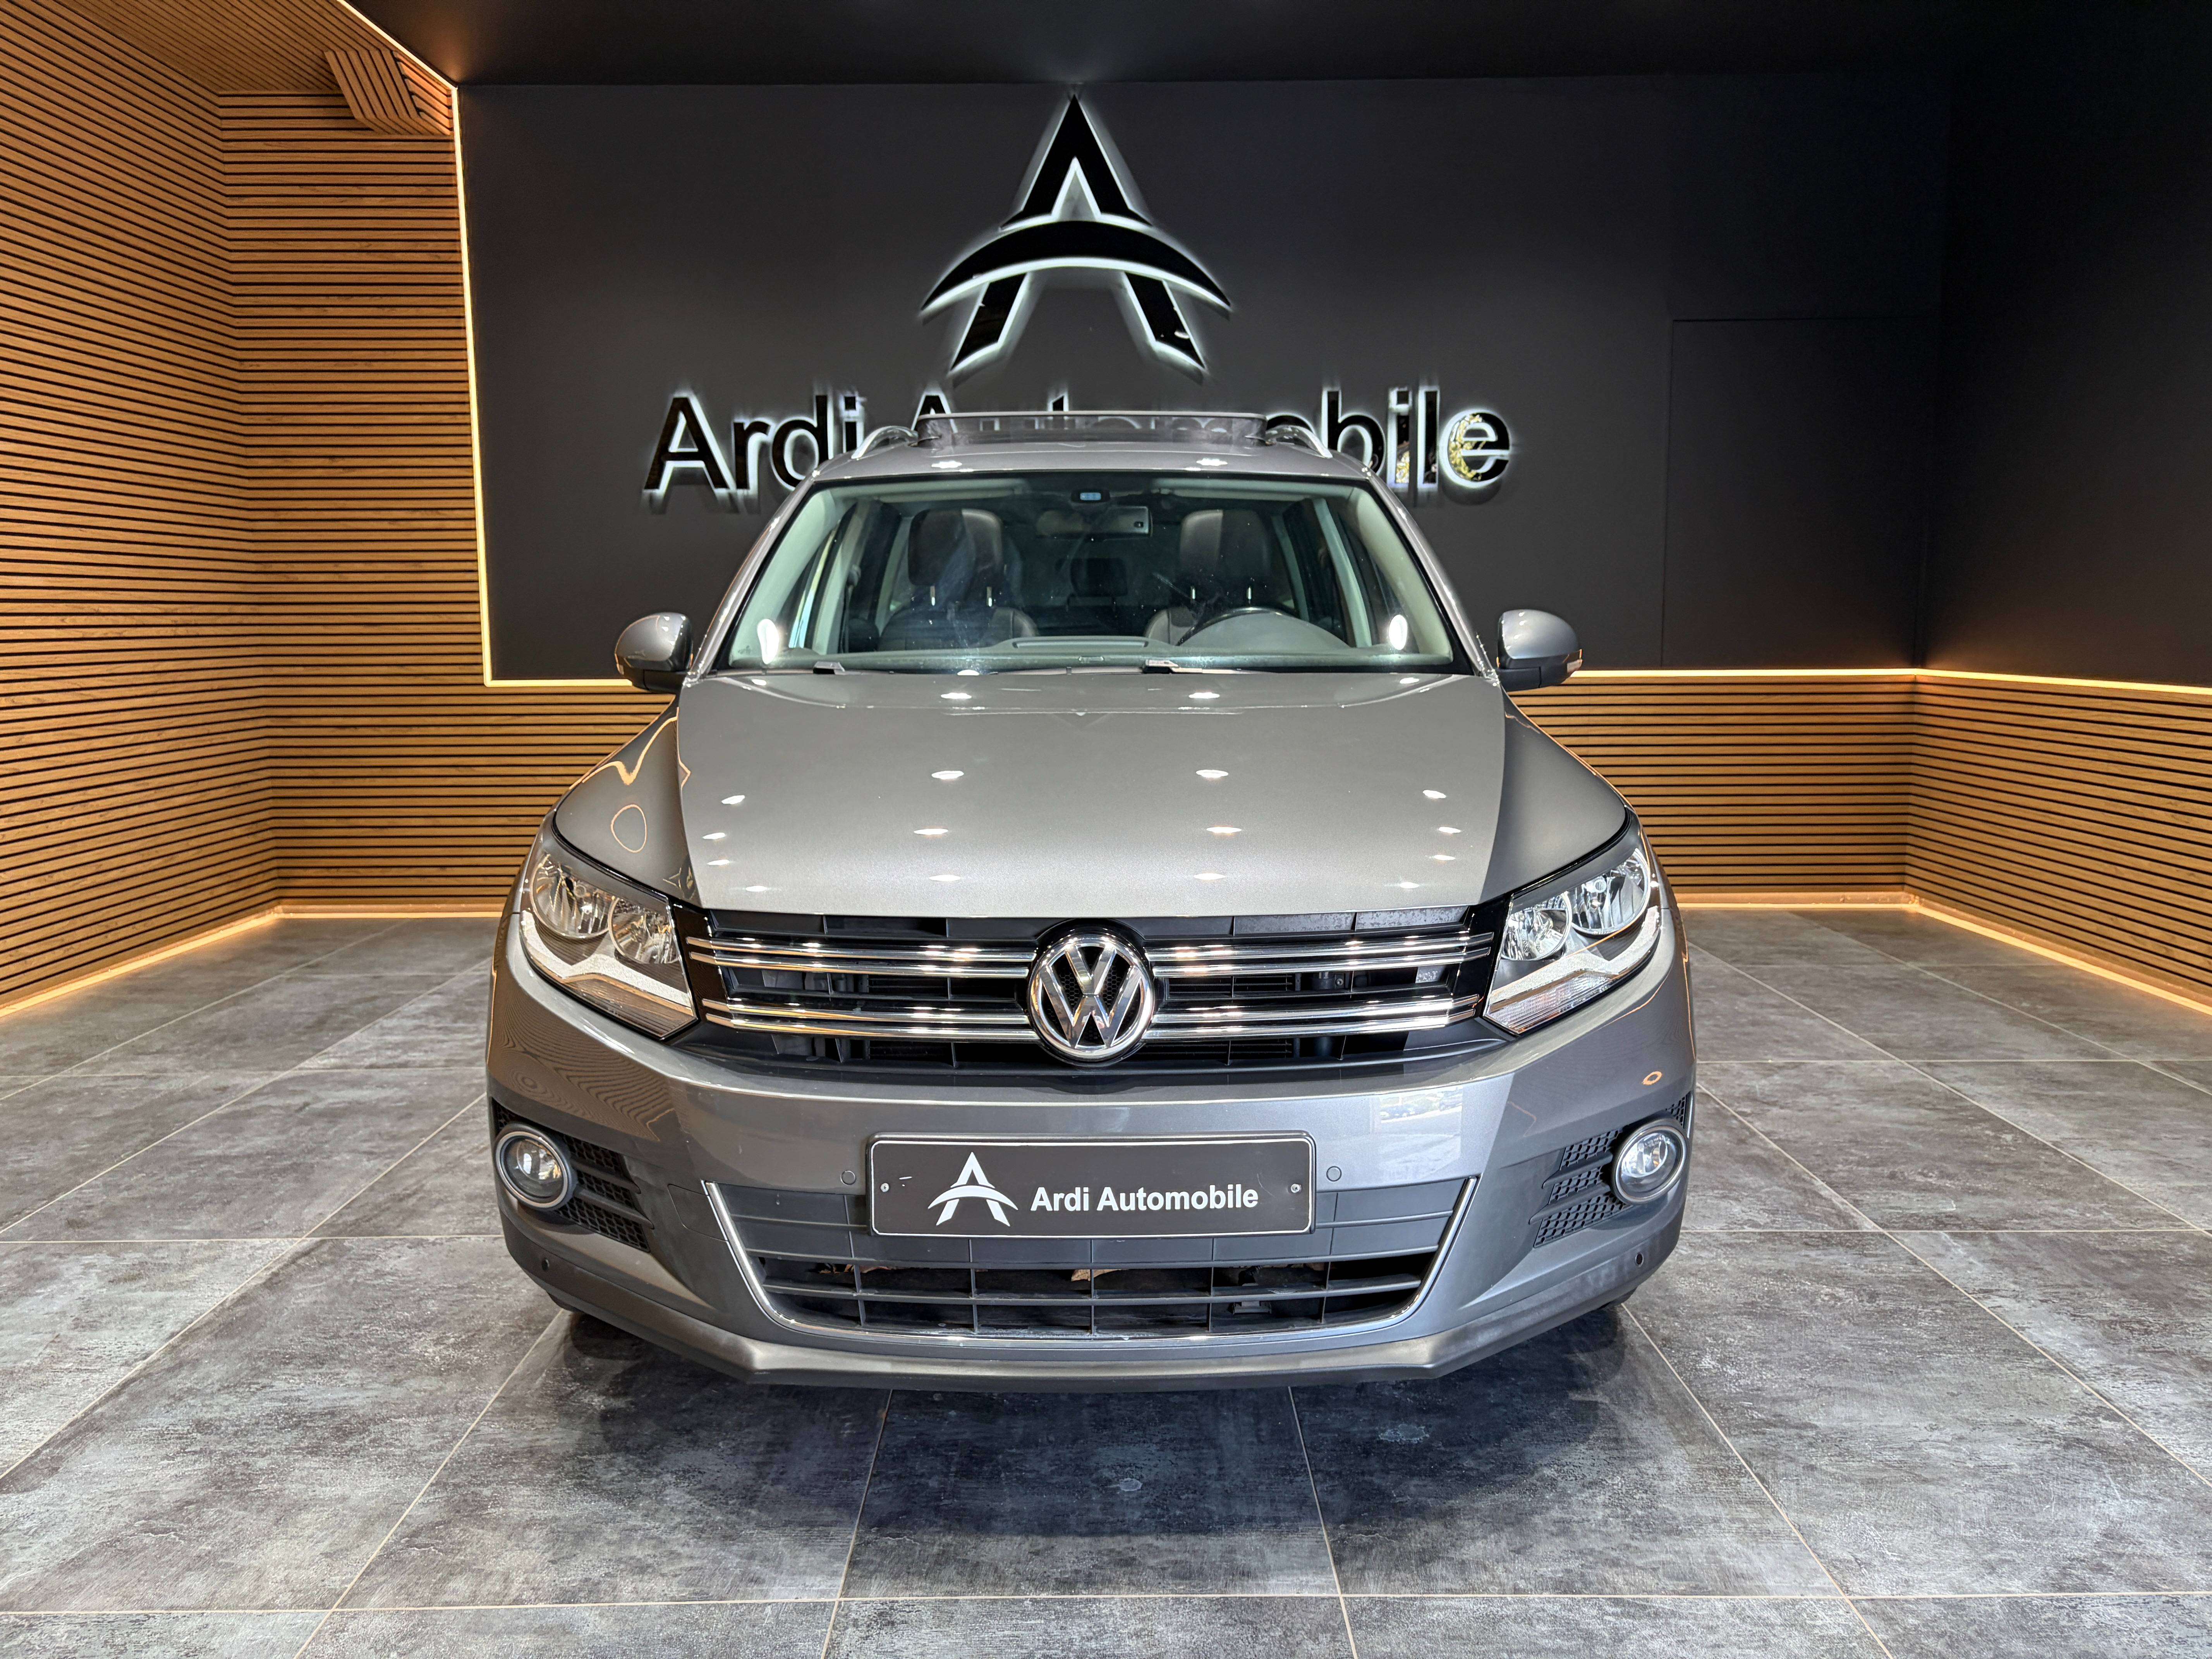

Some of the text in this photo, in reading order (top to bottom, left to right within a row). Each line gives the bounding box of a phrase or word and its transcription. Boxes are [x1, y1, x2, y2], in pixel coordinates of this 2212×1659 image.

[643, 393, 858, 490] Ardi
[1030, 1183, 1259, 1211] Ardi Automobile
